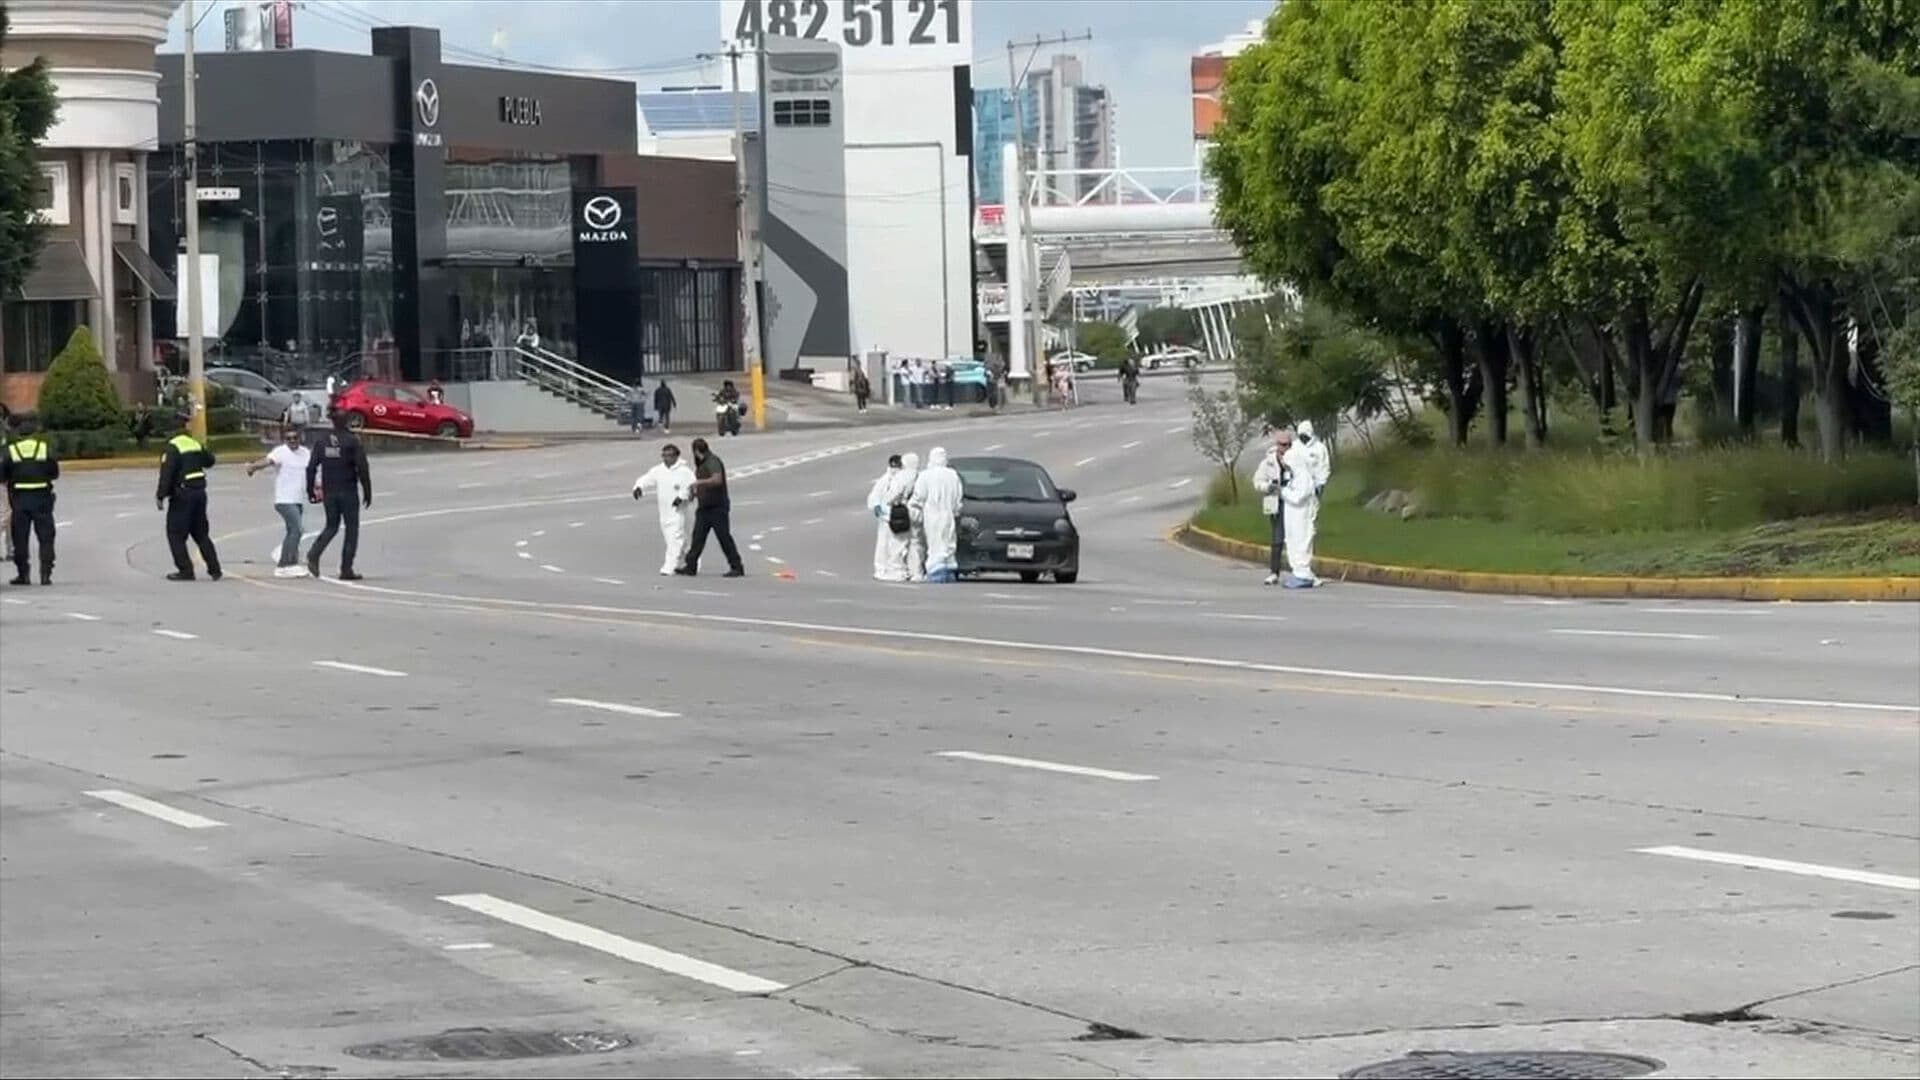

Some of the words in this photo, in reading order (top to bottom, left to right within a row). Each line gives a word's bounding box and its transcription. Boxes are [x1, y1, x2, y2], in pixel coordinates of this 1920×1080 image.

[735, 0, 829, 48] 482
[843, 0, 894, 46] 51
[908, 0, 960, 44] 21
[503, 96, 543, 125] PUEBLA
[579, 231, 628, 243] MAZDA
